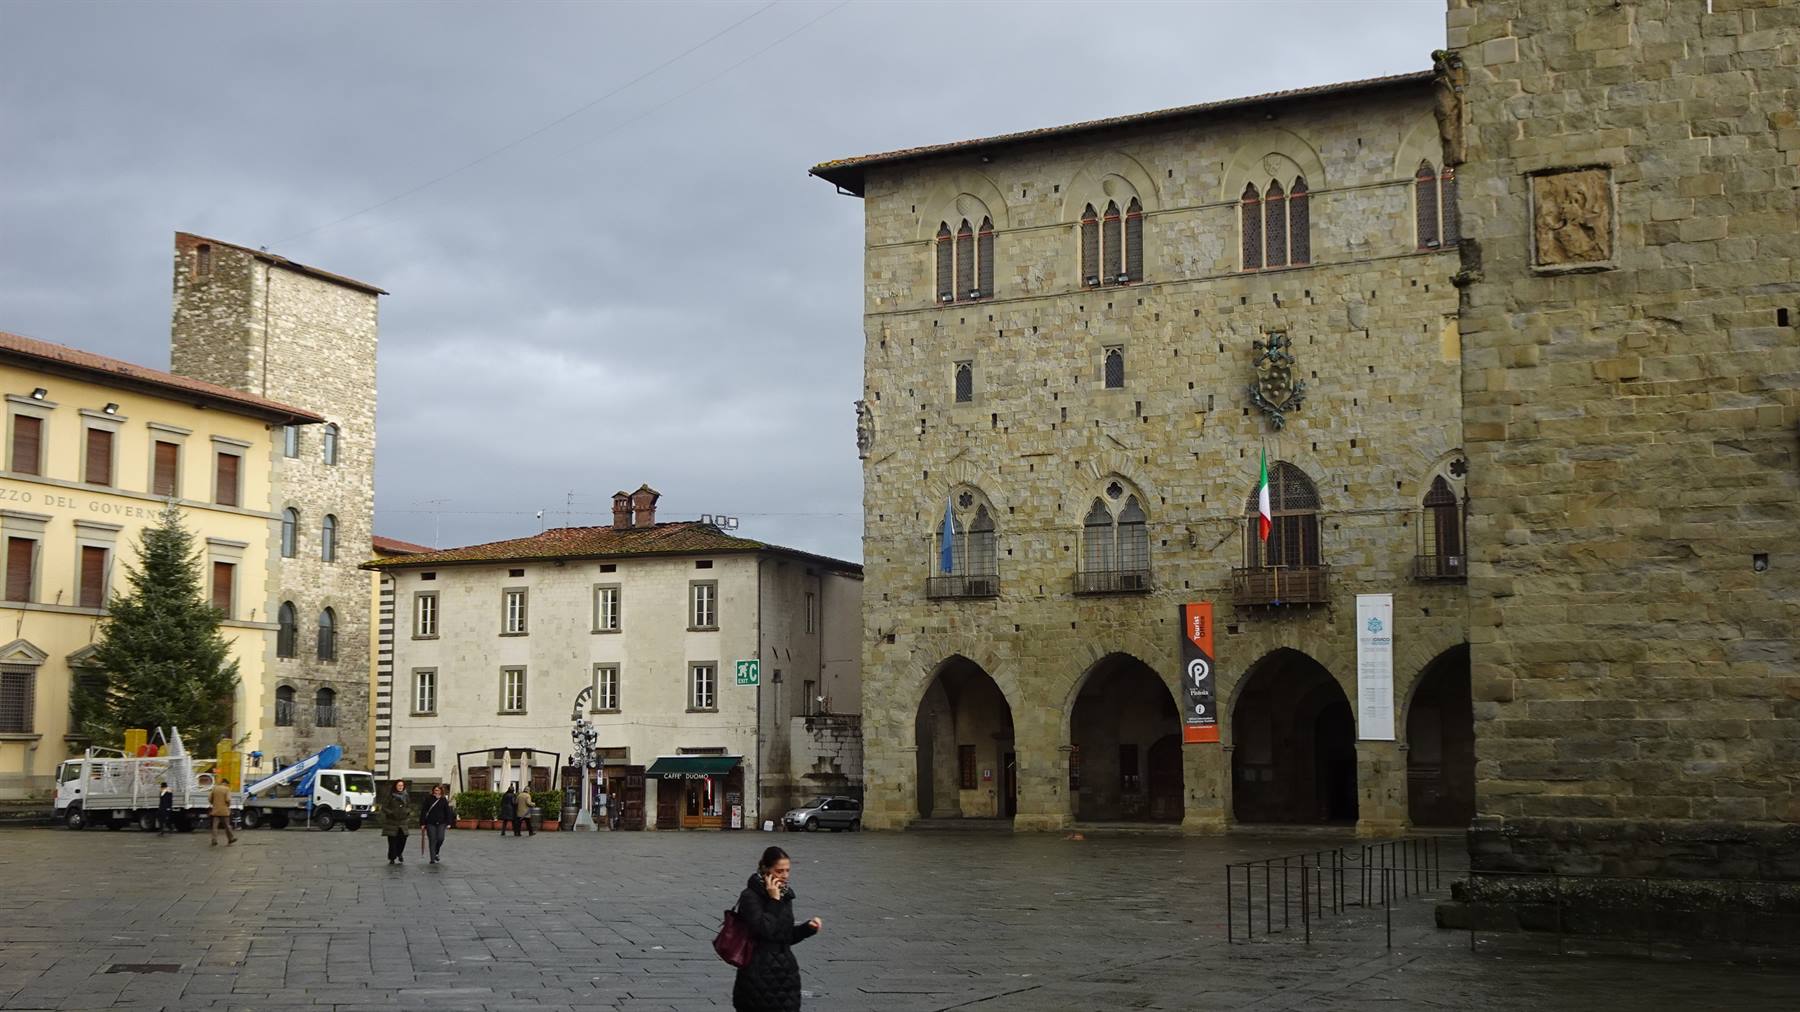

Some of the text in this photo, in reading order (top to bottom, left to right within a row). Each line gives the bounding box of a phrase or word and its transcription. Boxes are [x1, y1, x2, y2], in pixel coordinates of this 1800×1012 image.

[44, 494, 77, 509] DEL
[88, 500, 158, 520] GOVERN
[749, 663, 757, 682] C
[685, 772, 709, 780] DUOMO
